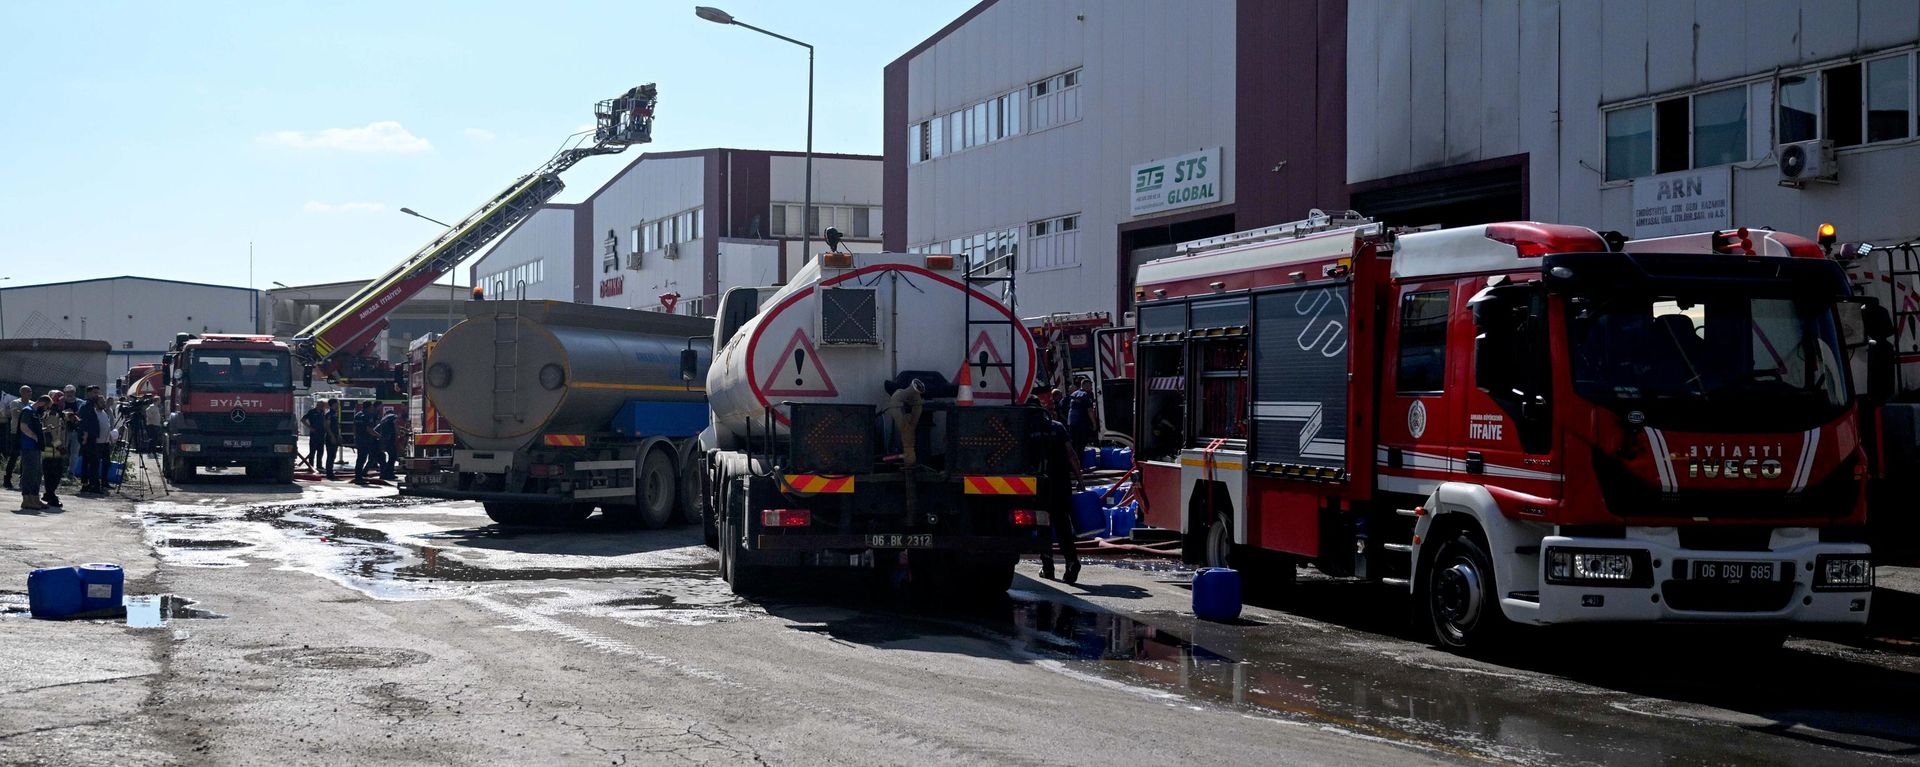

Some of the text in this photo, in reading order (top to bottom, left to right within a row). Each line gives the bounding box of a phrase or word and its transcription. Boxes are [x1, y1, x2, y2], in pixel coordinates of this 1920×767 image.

[1174, 156, 1208, 183] STS
[1168, 183, 1215, 205] GLOBAL
[1657, 177, 1702, 200] ARN
[1469, 421, 1503, 440] İTFAİYE
[1689, 459, 1782, 479] IVECO
[872, 535, 931, 546] 06 BK 2312
[1702, 564, 1771, 579] 06 DSU 685
